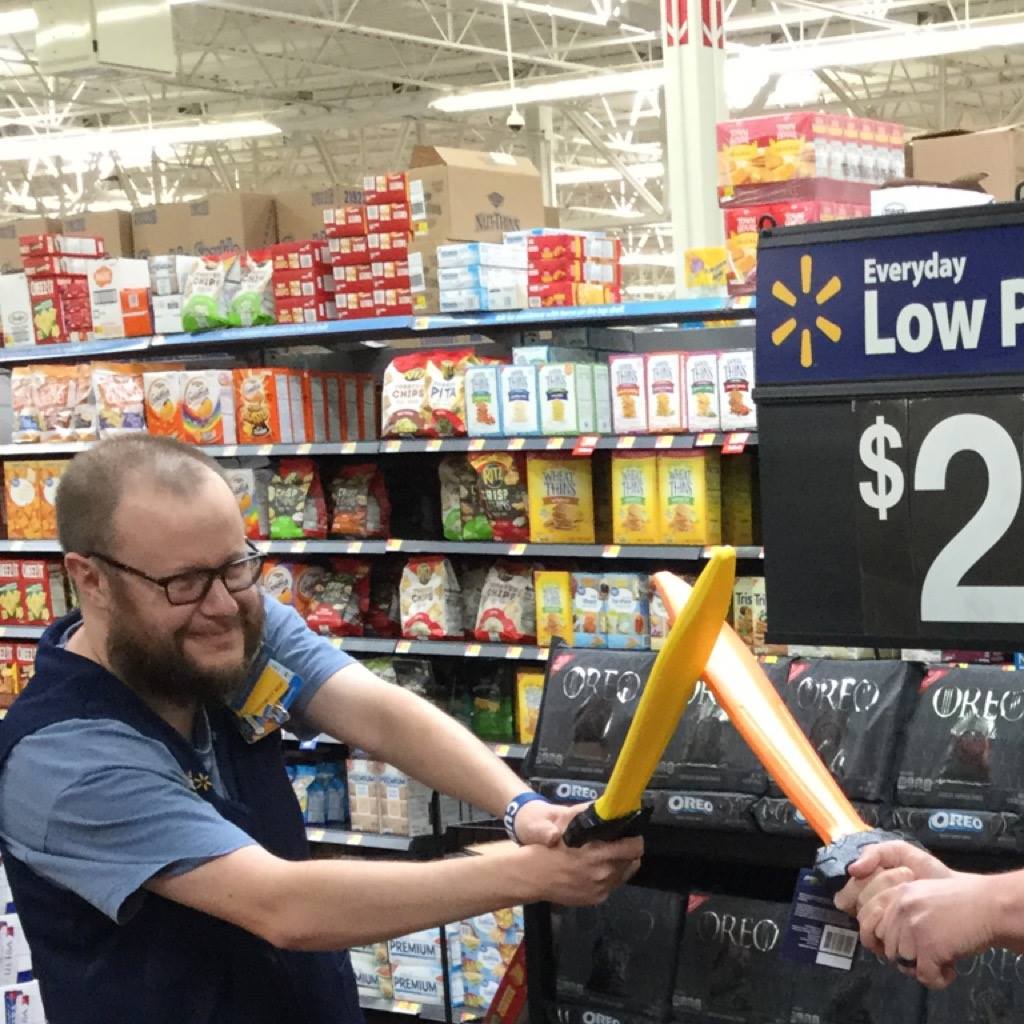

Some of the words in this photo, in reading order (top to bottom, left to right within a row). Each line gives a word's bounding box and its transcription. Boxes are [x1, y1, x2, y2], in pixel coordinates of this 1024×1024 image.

[864, 252, 967, 288] Everyday
[864, 288, 987, 355] Low
[557, 783, 598, 800] OREO
[669, 795, 713, 813] OREO
[931, 812, 983, 831] OREO
[391, 941, 436, 956] PREMIUM
[394, 976, 438, 993] PREMIUM
